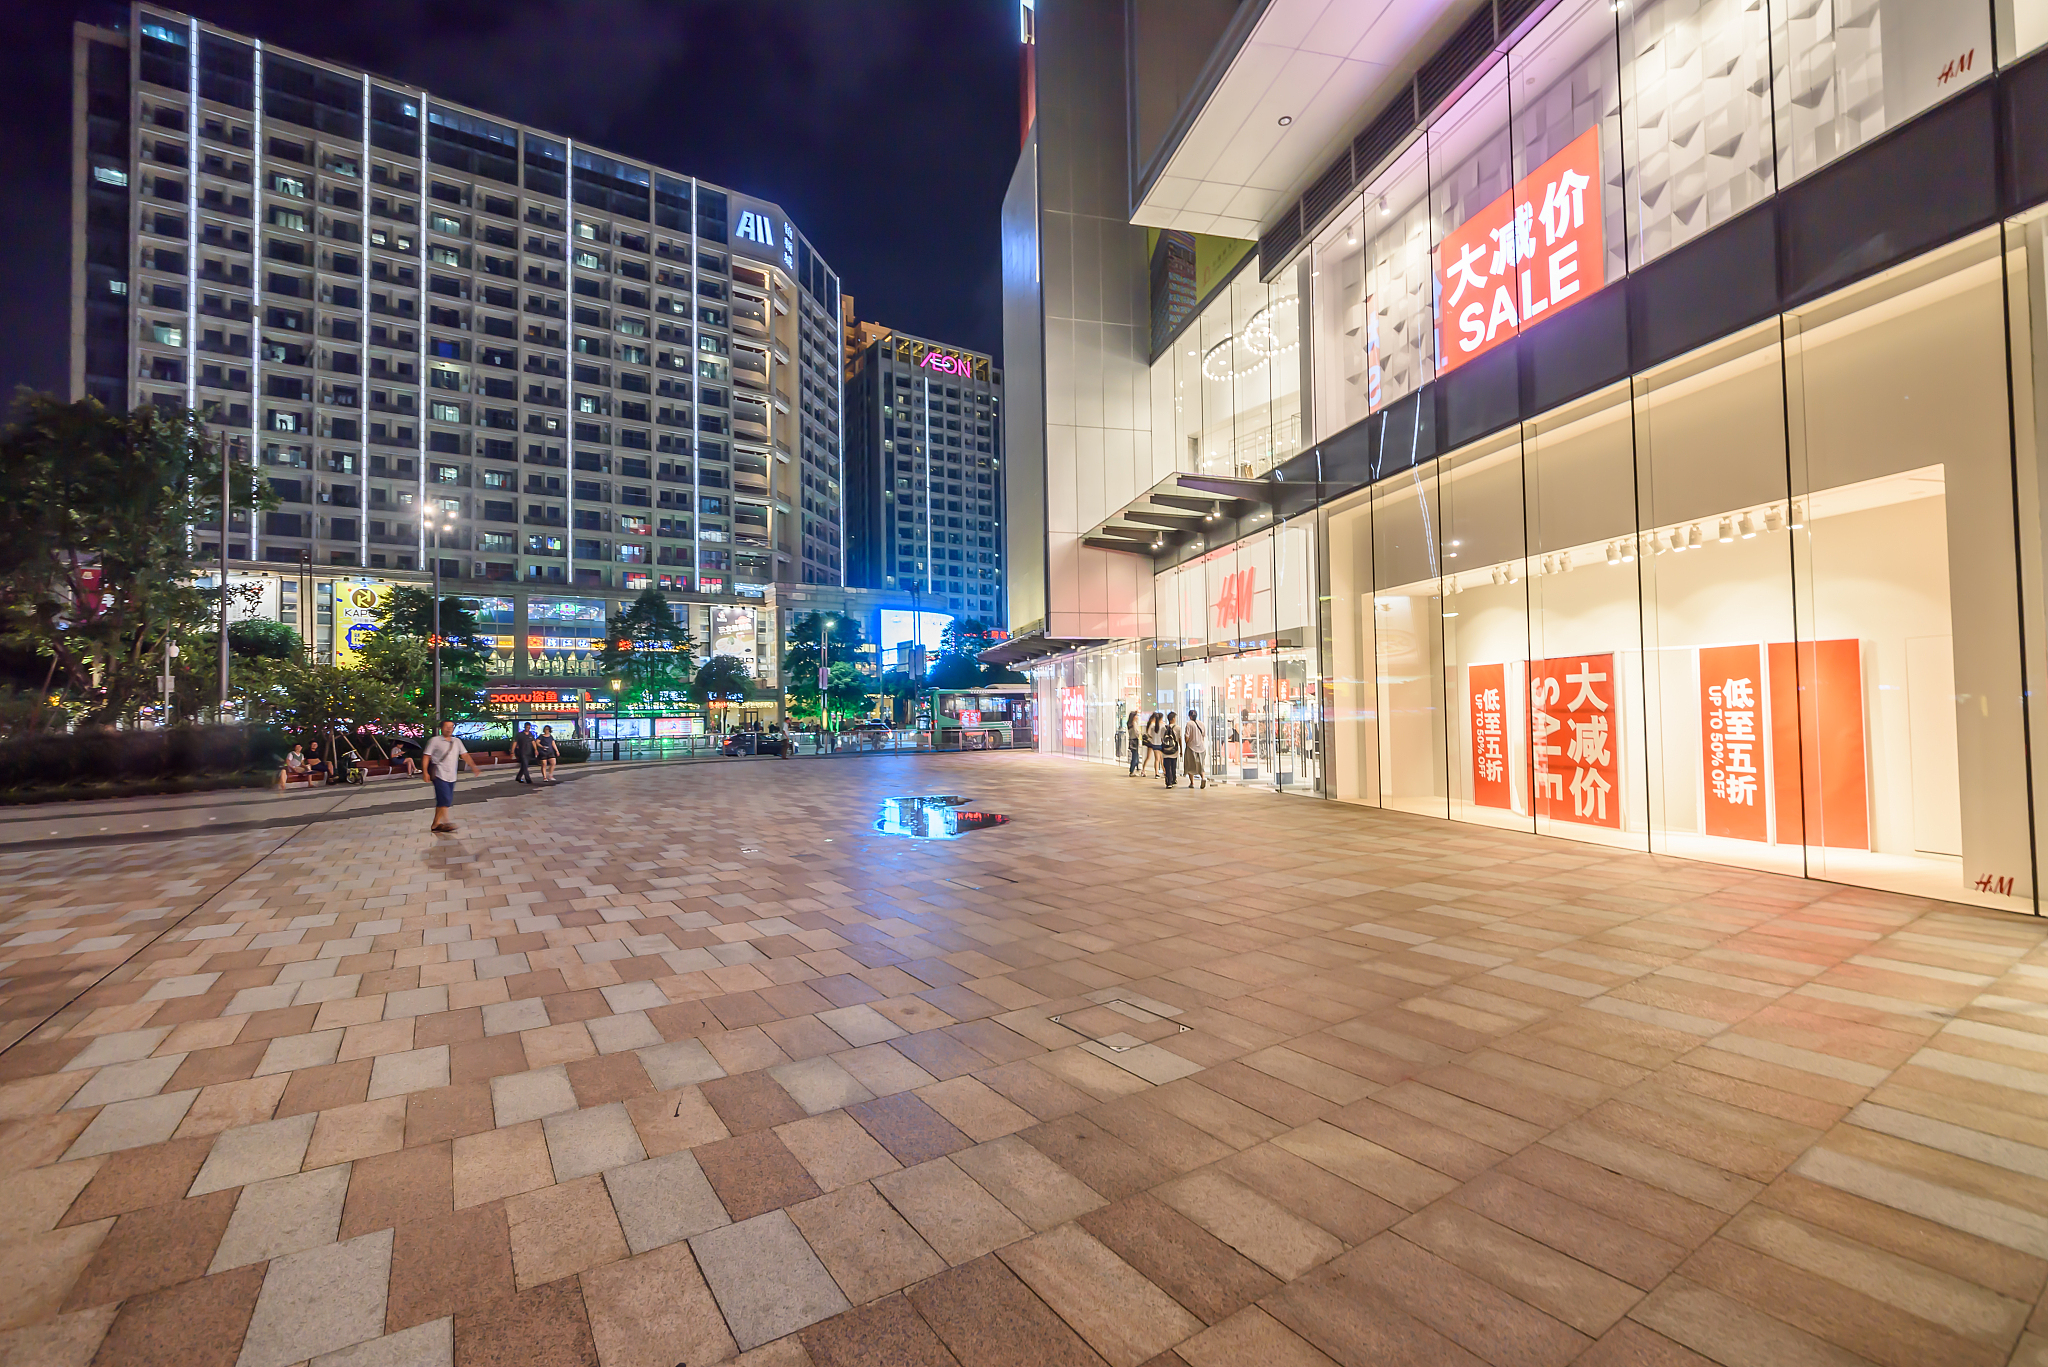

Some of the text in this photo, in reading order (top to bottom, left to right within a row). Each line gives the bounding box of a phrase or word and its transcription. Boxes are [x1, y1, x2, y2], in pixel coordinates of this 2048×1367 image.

[1937, 48, 1974, 87] H&M
[1446, 168, 1590, 308] 大减价
[1459, 239, 1580, 352] SALE
[1215, 565, 1255, 629] H&M
[532, 690, 558, 703] 盗鱼
[1064, 718, 1084, 740] SALE
[1475, 693, 1486, 778] UP TO 50% OFF
[1482, 688, 1504, 783] 低至五折
[1531, 676, 1564, 802] SALE
[1566, 662, 1612, 820] 大减价
[1708, 685, 1726, 799] UP TO 50% OFF
[1722, 677, 1758, 807] 低至五折
[1974, 872, 2015, 897] H&M
